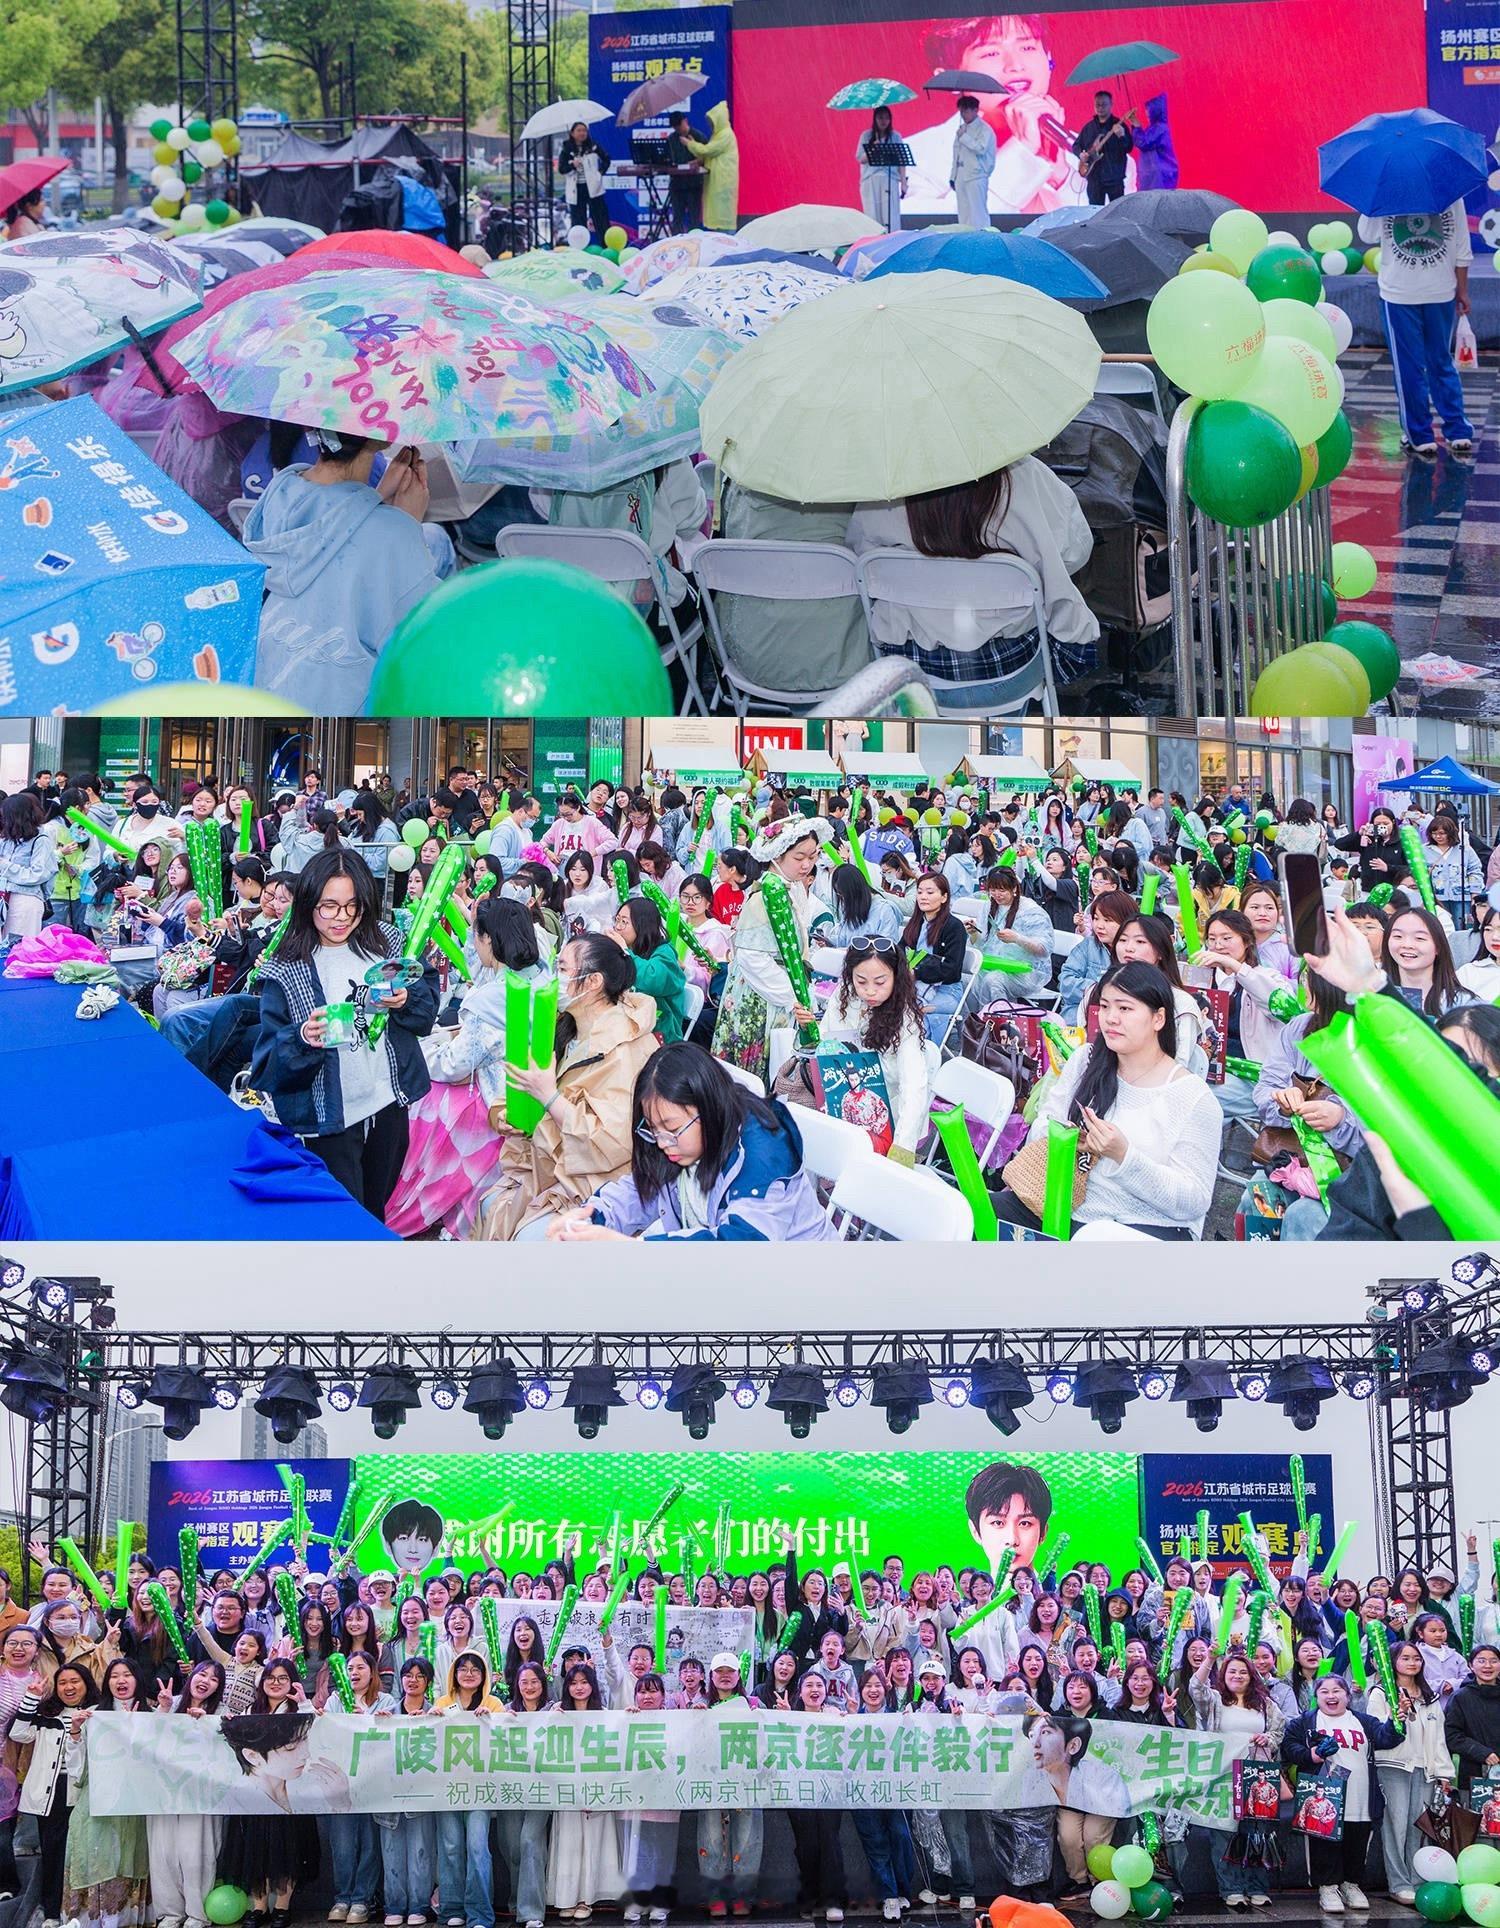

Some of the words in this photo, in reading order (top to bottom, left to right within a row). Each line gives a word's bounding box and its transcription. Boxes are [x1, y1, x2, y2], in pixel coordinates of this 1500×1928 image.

[168, 1488, 332, 1506] 2026江苏省城市足联赛
[1162, 1481, 1317, 1497] 2026江苏省城市足球赛
[231, 1520, 314, 1547] 观赛
[1136, 1730, 1224, 1781] 生日
